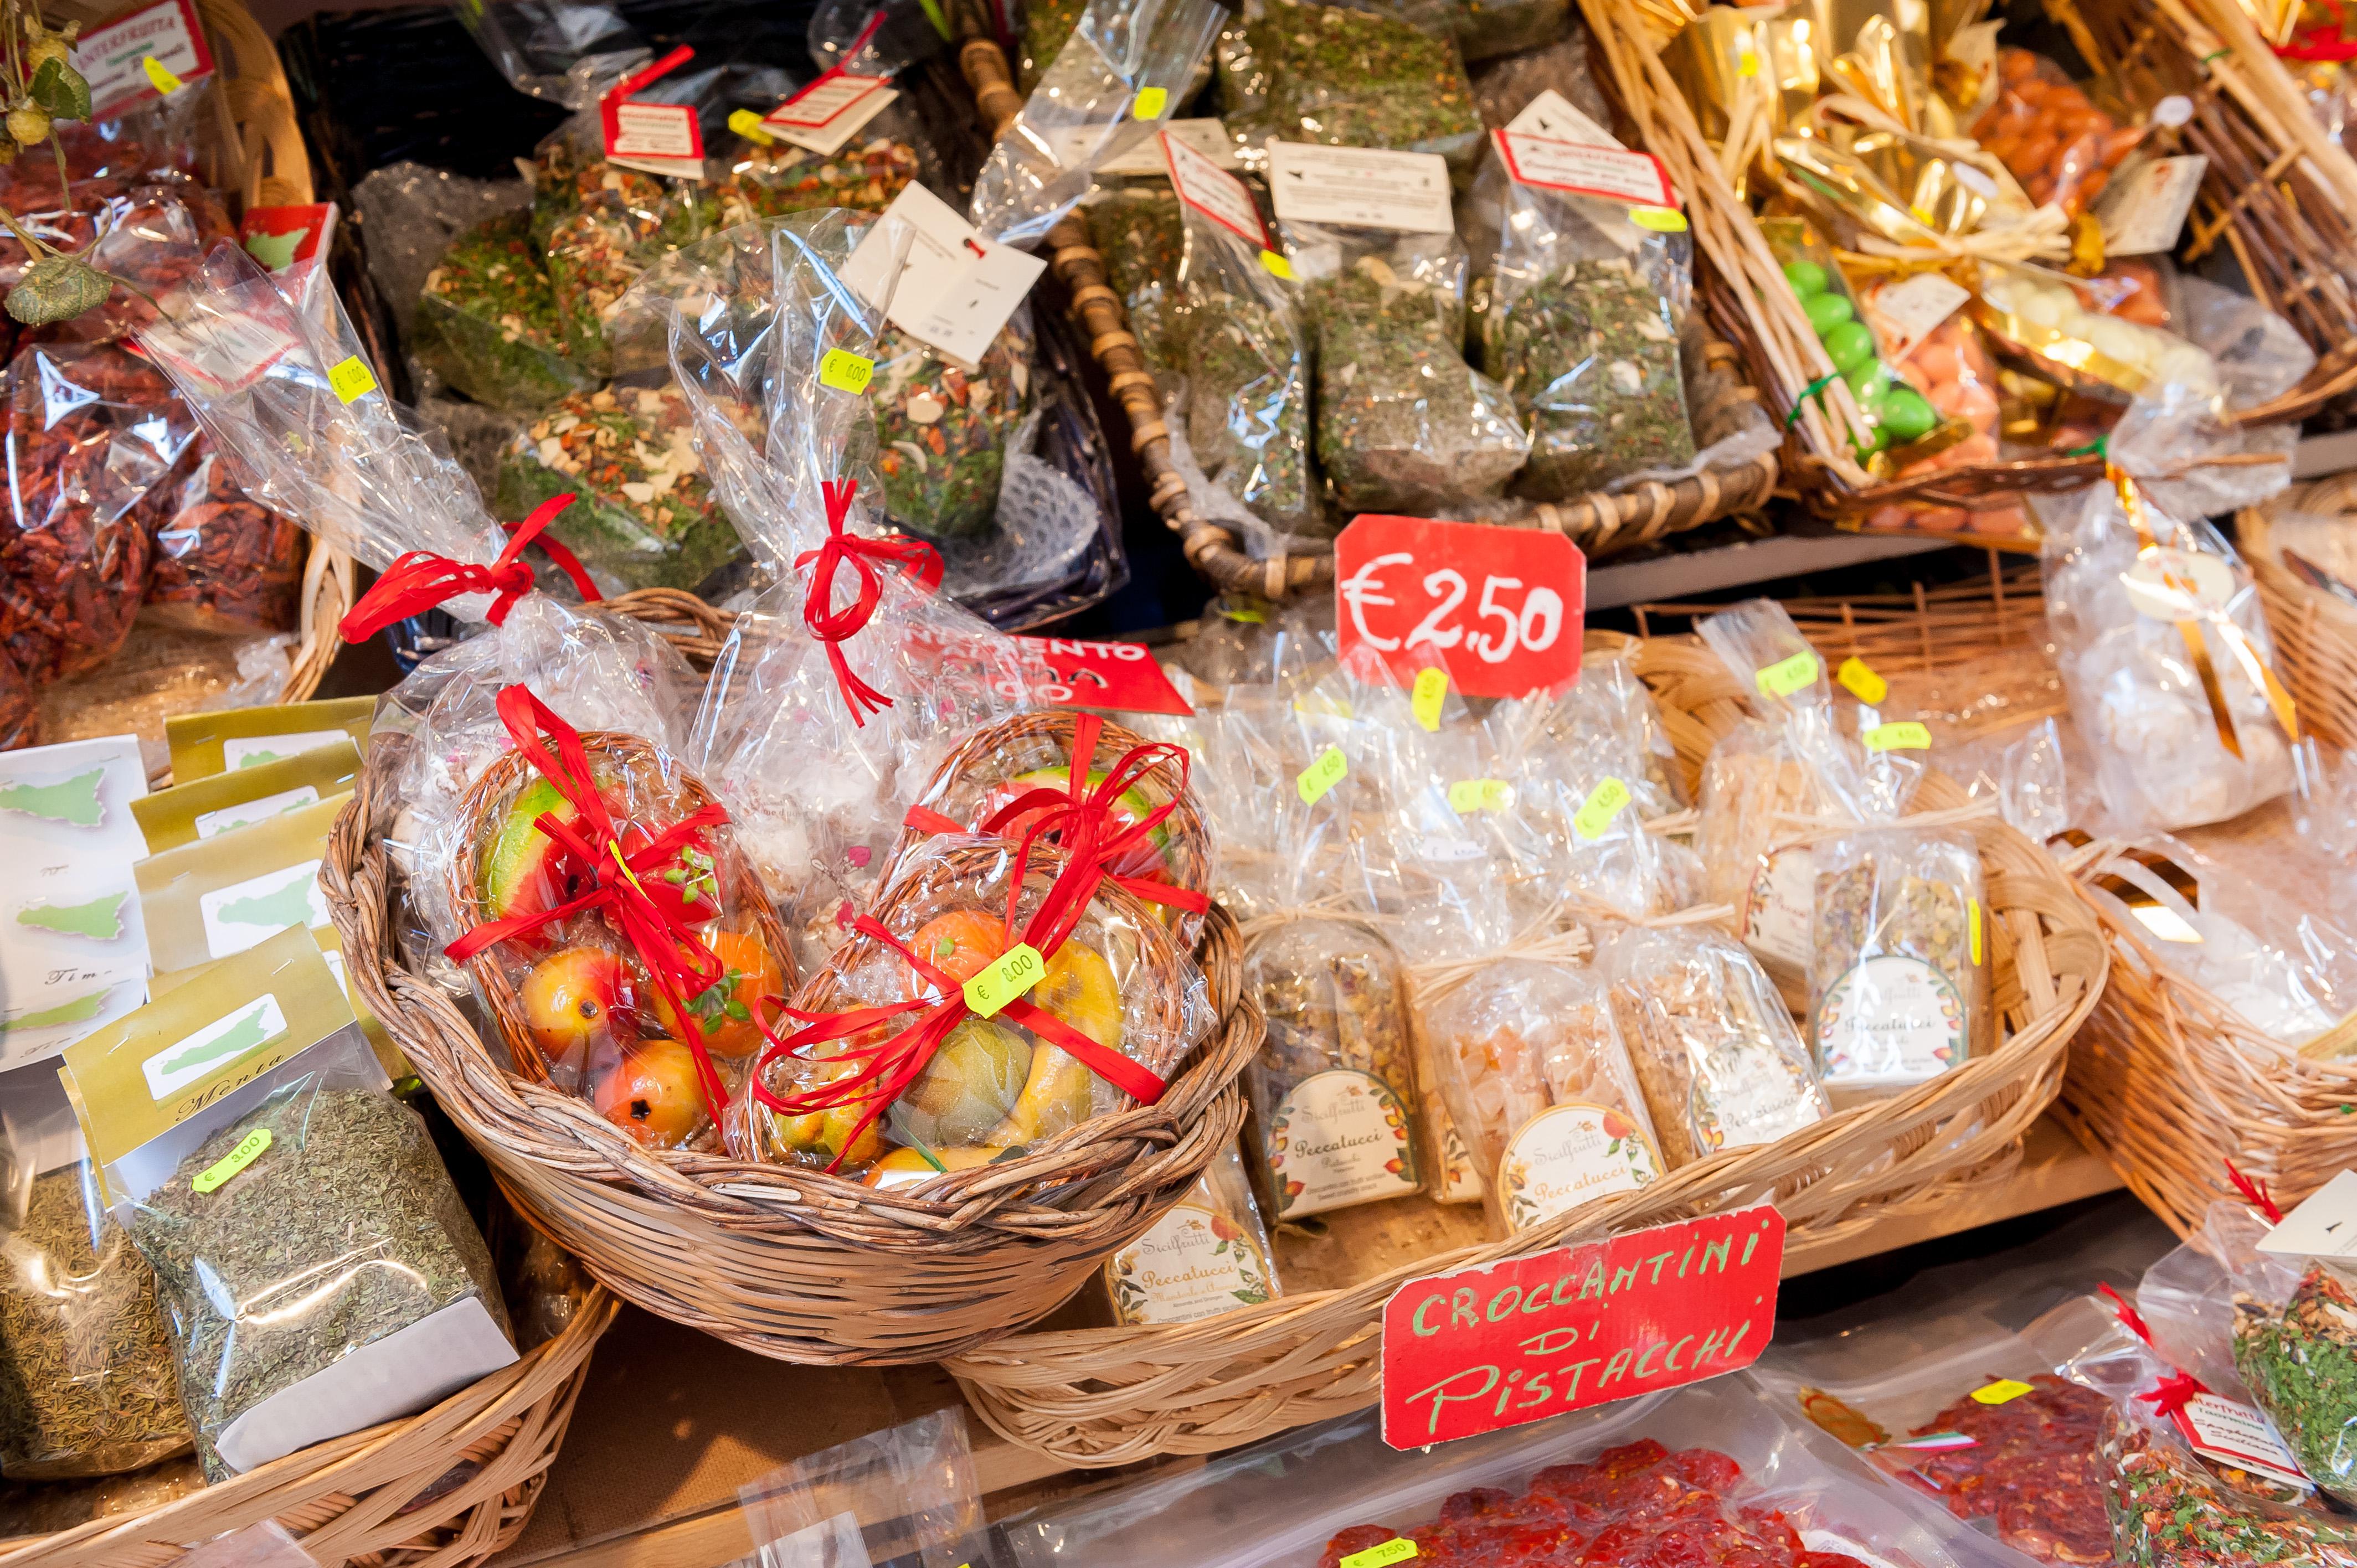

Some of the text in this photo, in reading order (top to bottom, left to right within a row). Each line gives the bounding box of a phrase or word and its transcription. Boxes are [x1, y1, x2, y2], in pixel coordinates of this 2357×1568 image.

[977, 955, 1033, 999] € 8.00
[175, 1054, 285, 1122] Menta
[204, 1136, 260, 1182] € 3.00
[1295, 1128, 1383, 1159] Peccatucci
[1533, 1132, 1602, 1166] Sicilfrutti
[1534, 1161, 1628, 1203] Peccatucci
[1141, 1228, 1211, 1256] Sicilfrutti
[1141, 1261, 1237, 1289] Peccatucci
[1376, 1543, 1406, 1558] 7.50
